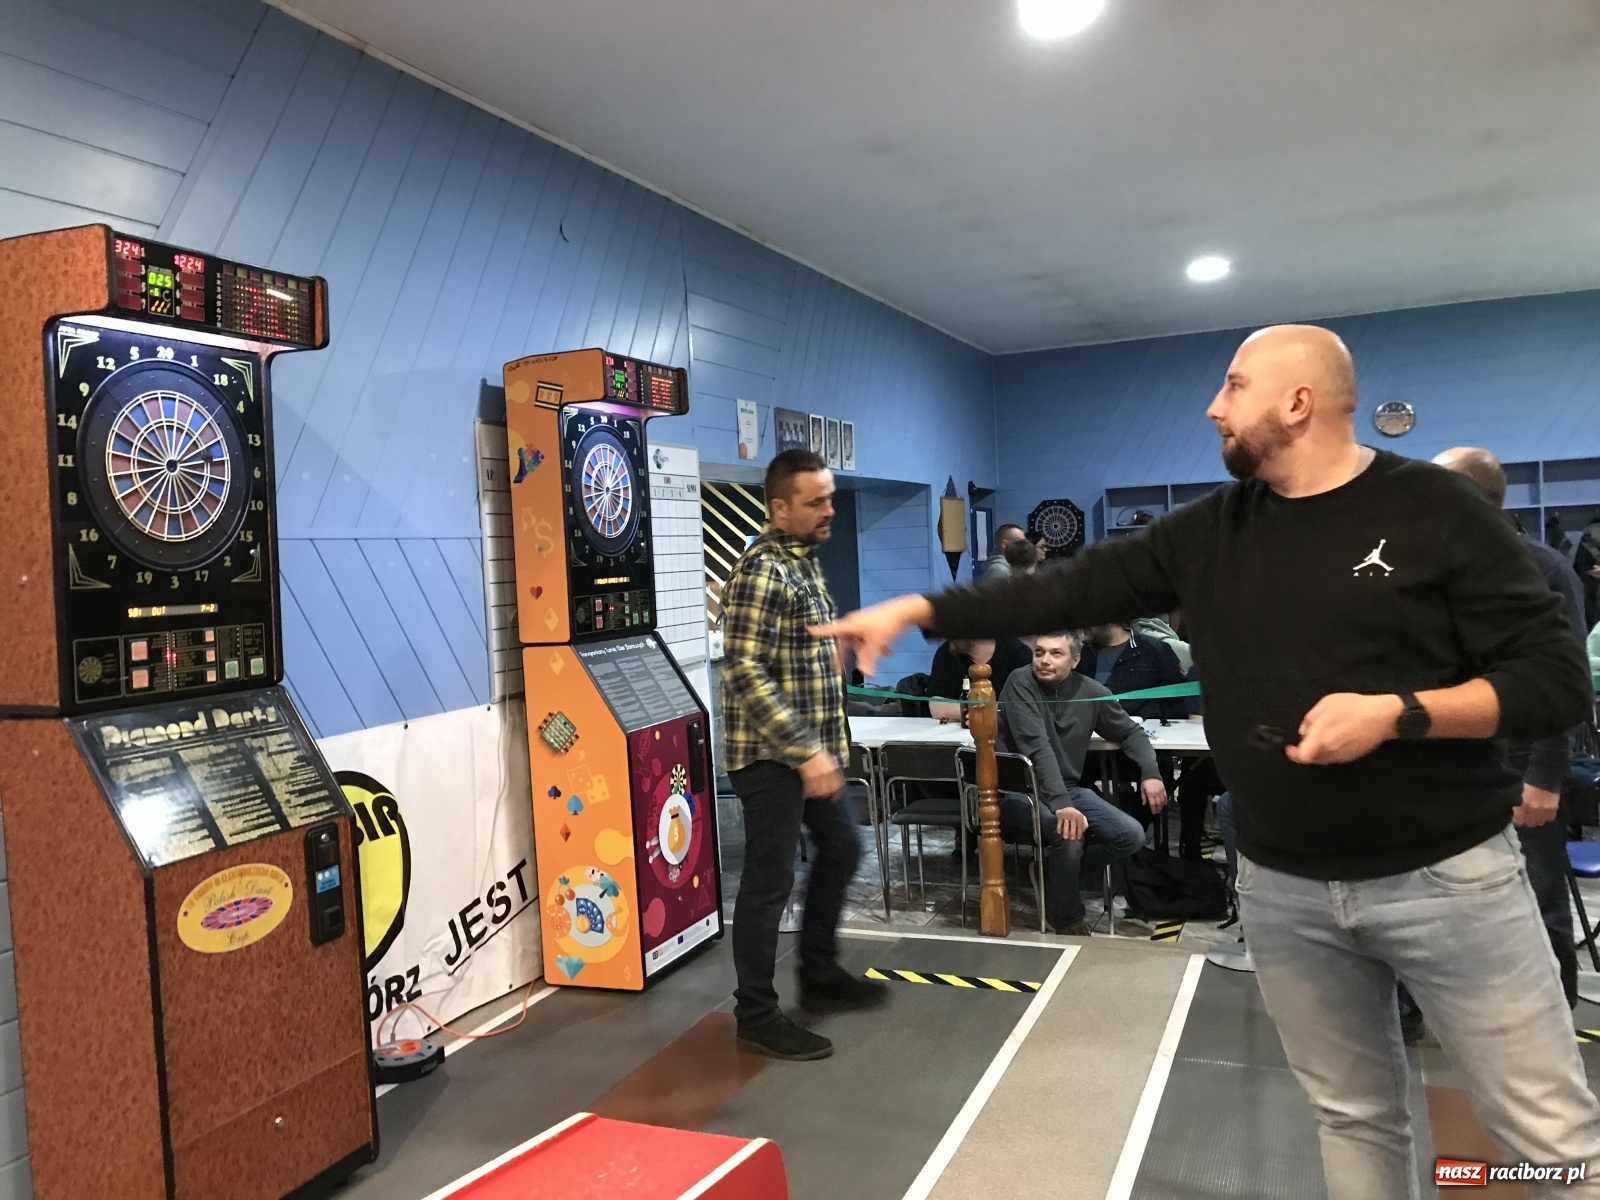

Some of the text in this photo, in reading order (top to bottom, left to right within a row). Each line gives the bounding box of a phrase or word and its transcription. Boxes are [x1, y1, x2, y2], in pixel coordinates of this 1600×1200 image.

[115, 240, 139, 255] 324
[130, 347, 139, 360] 5
[156, 346, 174, 359] 20
[97, 356, 115, 371] 12
[191, 355, 198, 367] 1
[214, 374, 228, 386] 18
[79, 382, 90, 396] 9
[236, 401, 244, 413] 4
[58, 414, 77, 429] 14
[247, 434, 261, 446] 13
[57, 455, 75, 467] 11
[254, 467, 261, 479] 6
[67, 493, 77, 505] 8
[250, 500, 264, 511] 10
[80, 529, 98, 541] 16
[239, 531, 253, 542] 15
[107, 555, 117, 568] 7
[224, 556, 231, 567] 2
[136, 571, 153, 584] 19
[171, 576, 179, 588] 3
[194, 571, 209, 582] 17
[101, 706, 278, 750] Diamond Darts
[445, 858, 528, 966] JEST
[227, 930, 249, 946] Cup
